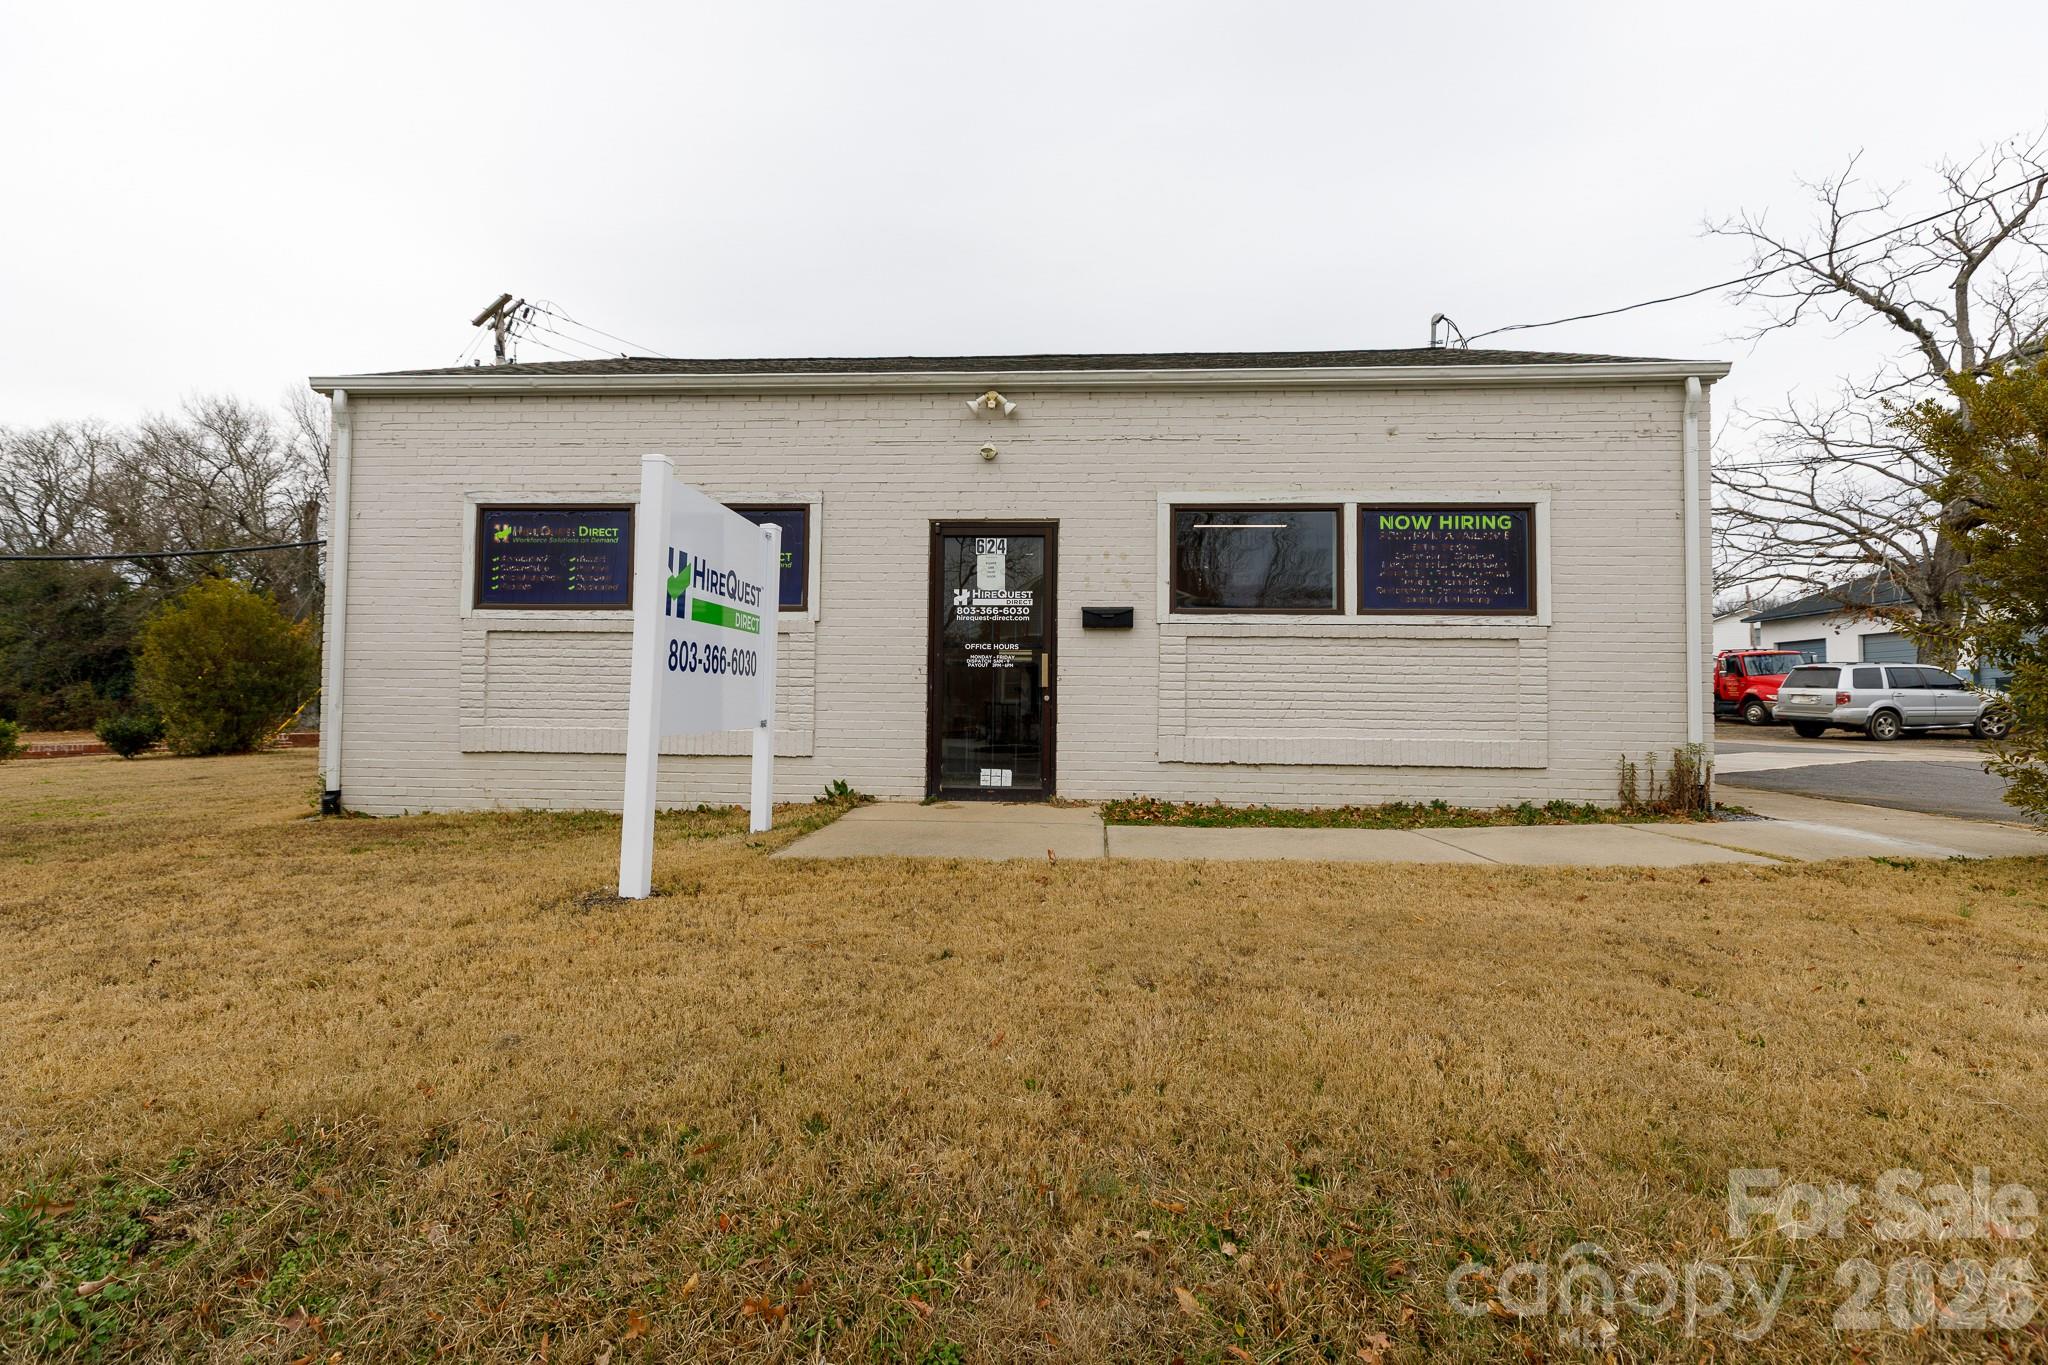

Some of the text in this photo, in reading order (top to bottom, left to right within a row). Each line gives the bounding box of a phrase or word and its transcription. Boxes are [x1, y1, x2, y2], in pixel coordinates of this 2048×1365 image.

[1379, 515, 1512, 530] NOW HIRING
[578, 525, 619, 537] DIRECT
[976, 539, 1006, 555] 624
[956, 607, 1030, 615] 803-366-6030
[735, 612, 760, 631] DIRECT
[668, 638, 757, 677] 803-366-6030
